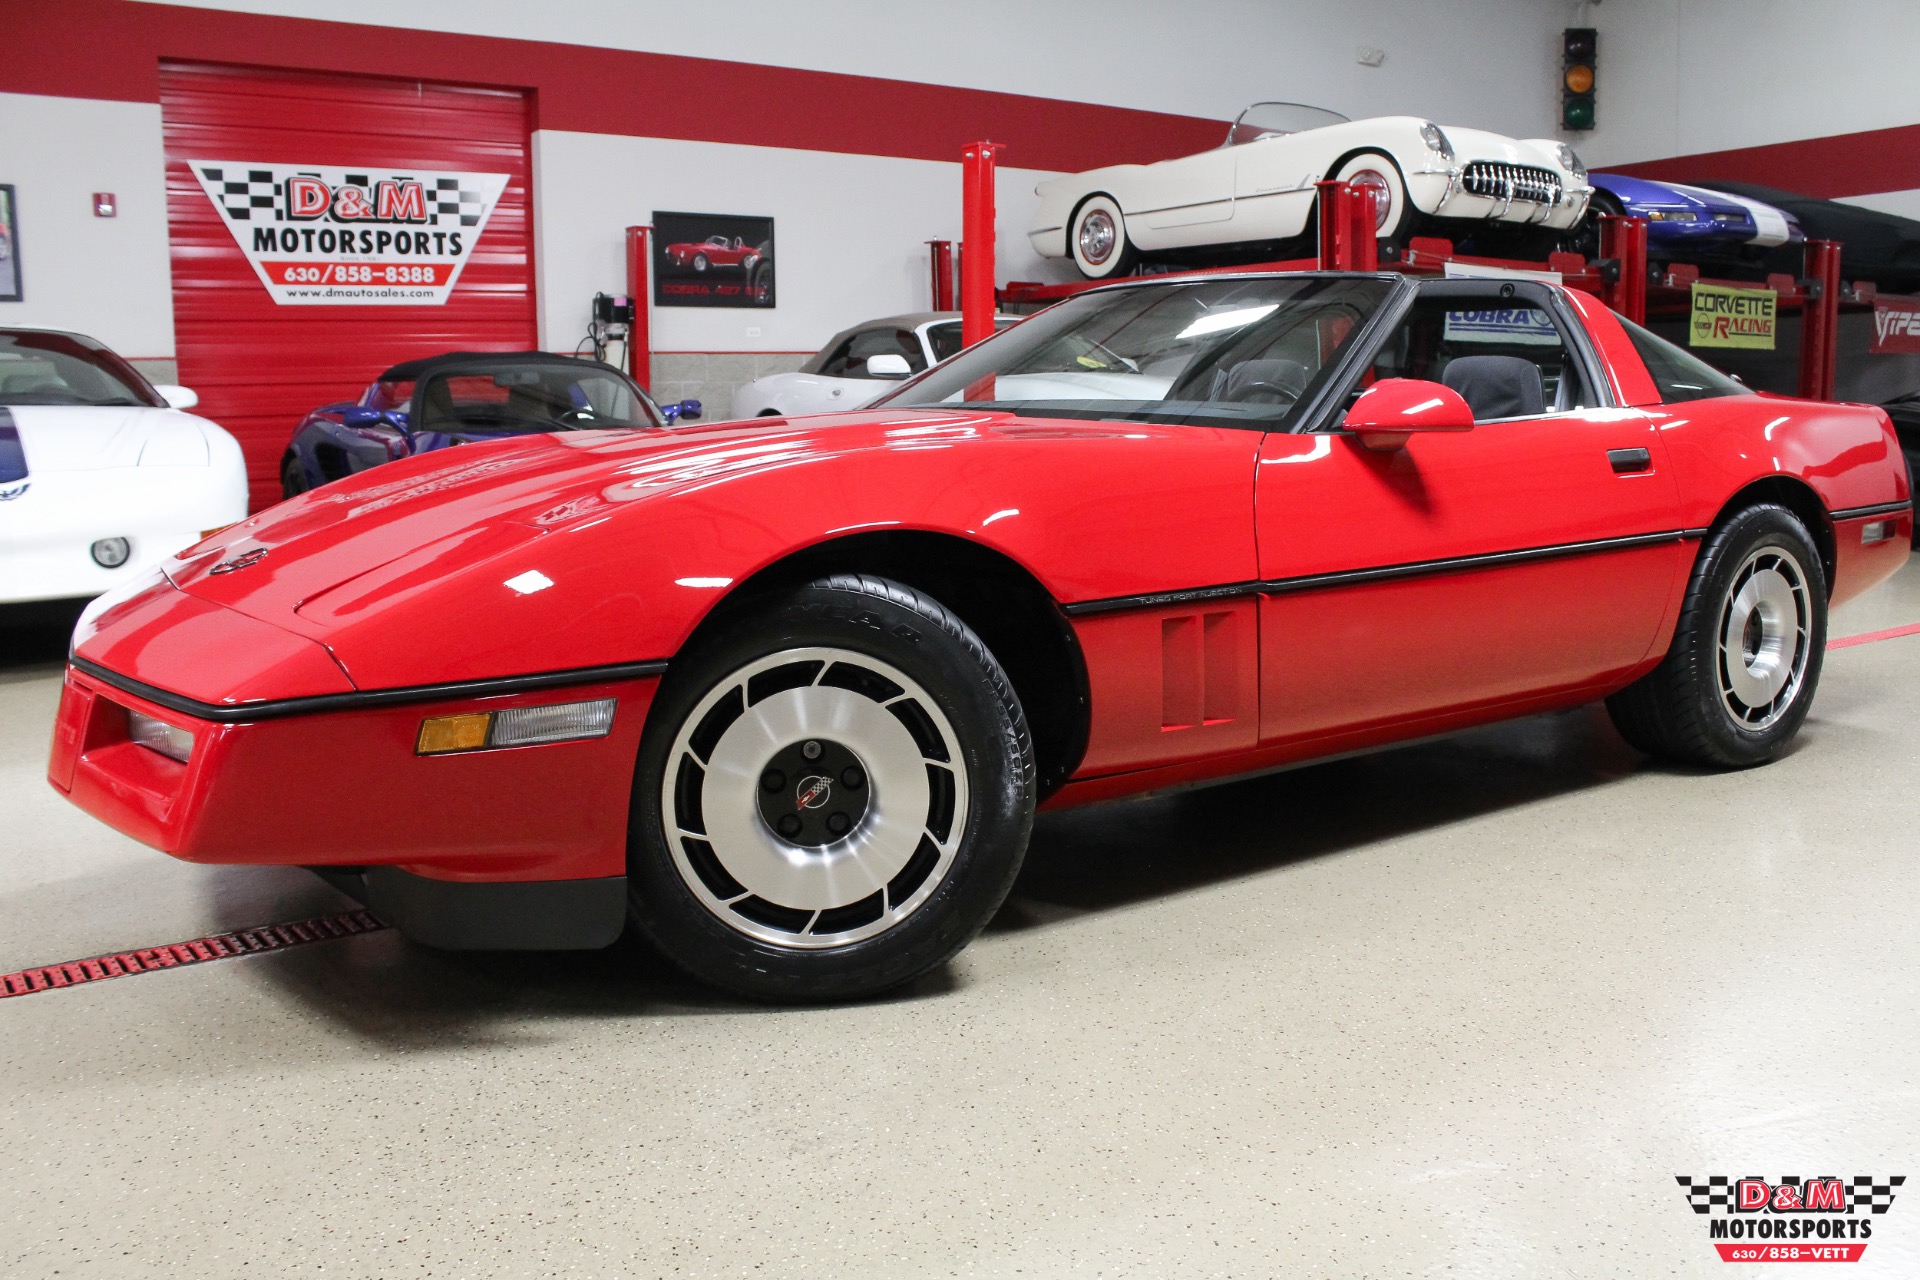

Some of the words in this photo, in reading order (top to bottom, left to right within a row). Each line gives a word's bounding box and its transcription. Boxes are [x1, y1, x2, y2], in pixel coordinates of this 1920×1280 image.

[285, 177, 427, 224] D&M
[253, 227, 463, 256] MOTORSPORTS
[284, 264, 435, 284] 630/858-8388
[286, 287, 434, 299] www.dmautosales.com
[1694, 292, 1773, 316] CORVETTE
[1713, 316, 1772, 339] RACING
[1173, 592, 1197, 601] PORT
